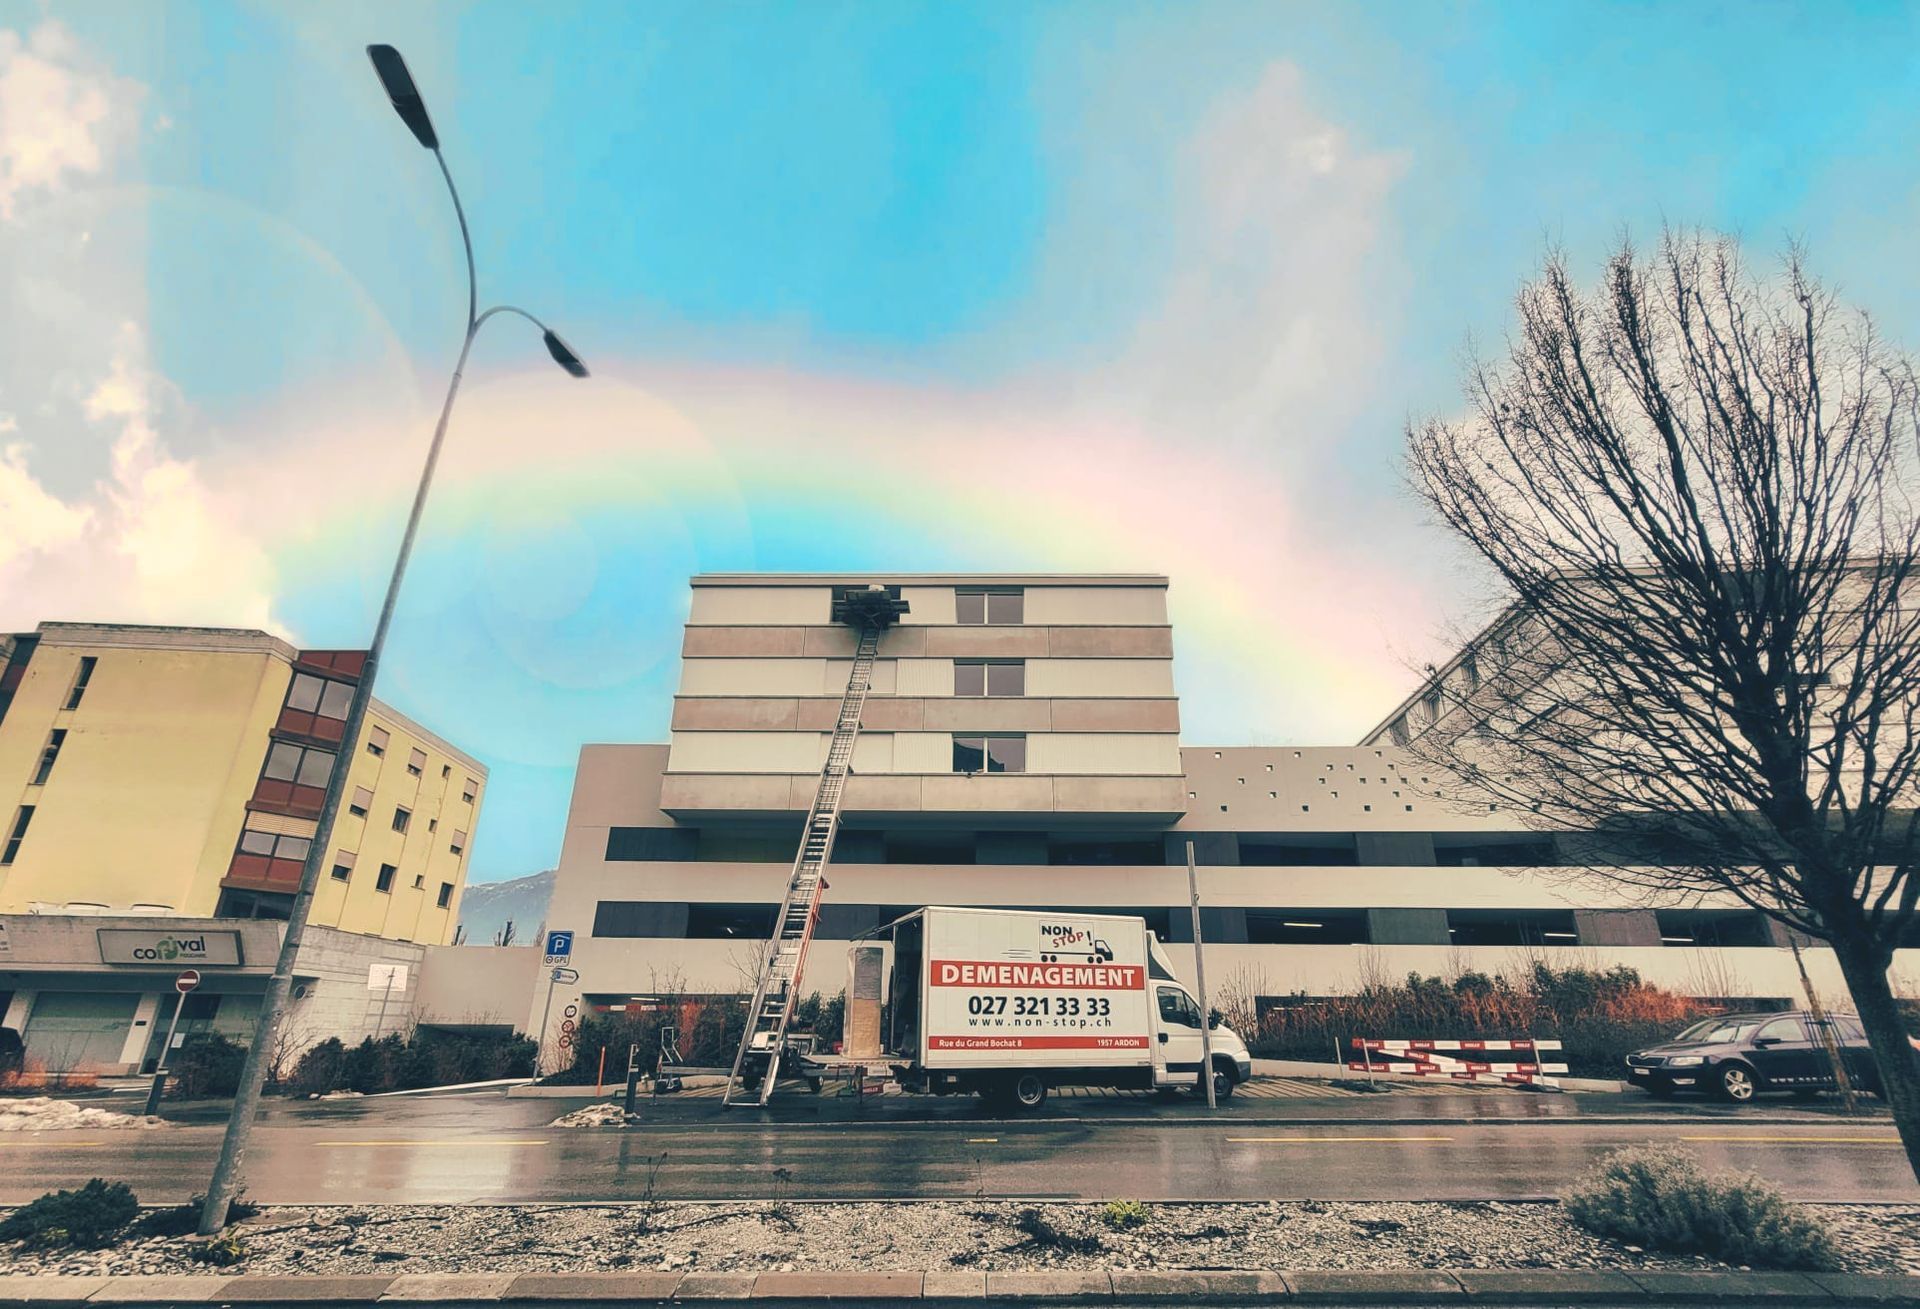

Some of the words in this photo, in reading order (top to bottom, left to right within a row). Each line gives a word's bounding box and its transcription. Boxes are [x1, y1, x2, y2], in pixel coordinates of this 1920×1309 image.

[1041, 925, 1072, 935] NON
[554, 939, 565, 953] P
[941, 964, 1135, 987] DEMENAGEMENT
[968, 995, 1008, 1015] 027
[1014, 996, 1049, 1015] 321
[1056, 997, 1080, 1016] 33
[1086, 998, 1111, 1016] 33
[968, 1017, 1112, 1029] www.non-stop.ch
[939, 1039, 954, 1047] Rue
[955, 1039, 965, 1047] du
[966, 1039, 989, 1047] Grand
[990, 1039, 1016, 1047] Bochat
[1097, 1039, 1113, 1047] 1957
[1114, 1039, 1140, 1047] ARDON
